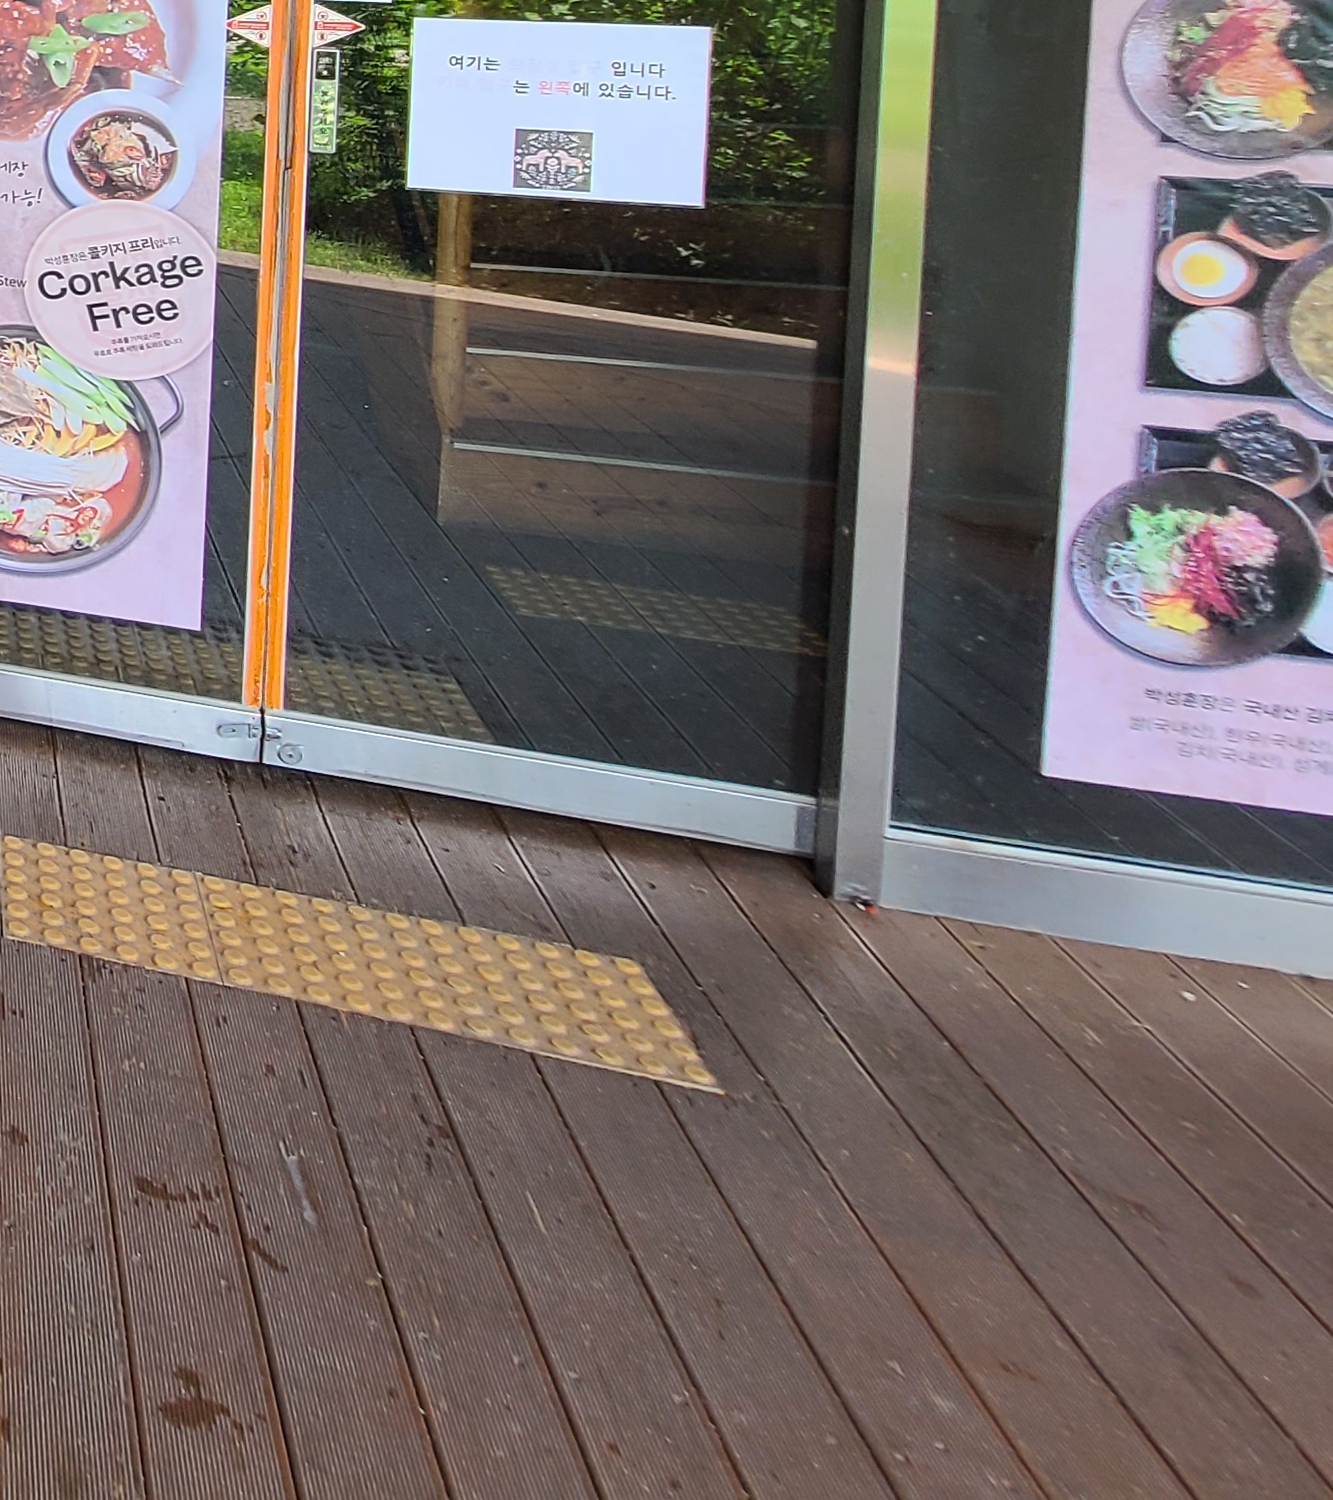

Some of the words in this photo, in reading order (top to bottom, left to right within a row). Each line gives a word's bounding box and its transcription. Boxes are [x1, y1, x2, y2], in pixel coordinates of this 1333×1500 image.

[449, 55, 501, 72] 여기는
[611, 61, 666, 78] 입니다
[538, 80, 590, 97] 왼쪽에
[598, 82, 677, 101] 있습니다.
[0, 187, 43, 207] 가능!
[88, 242, 127, 260] 콜키지
[38, 254, 204, 300] Corkage
[86, 299, 180, 332] Free
